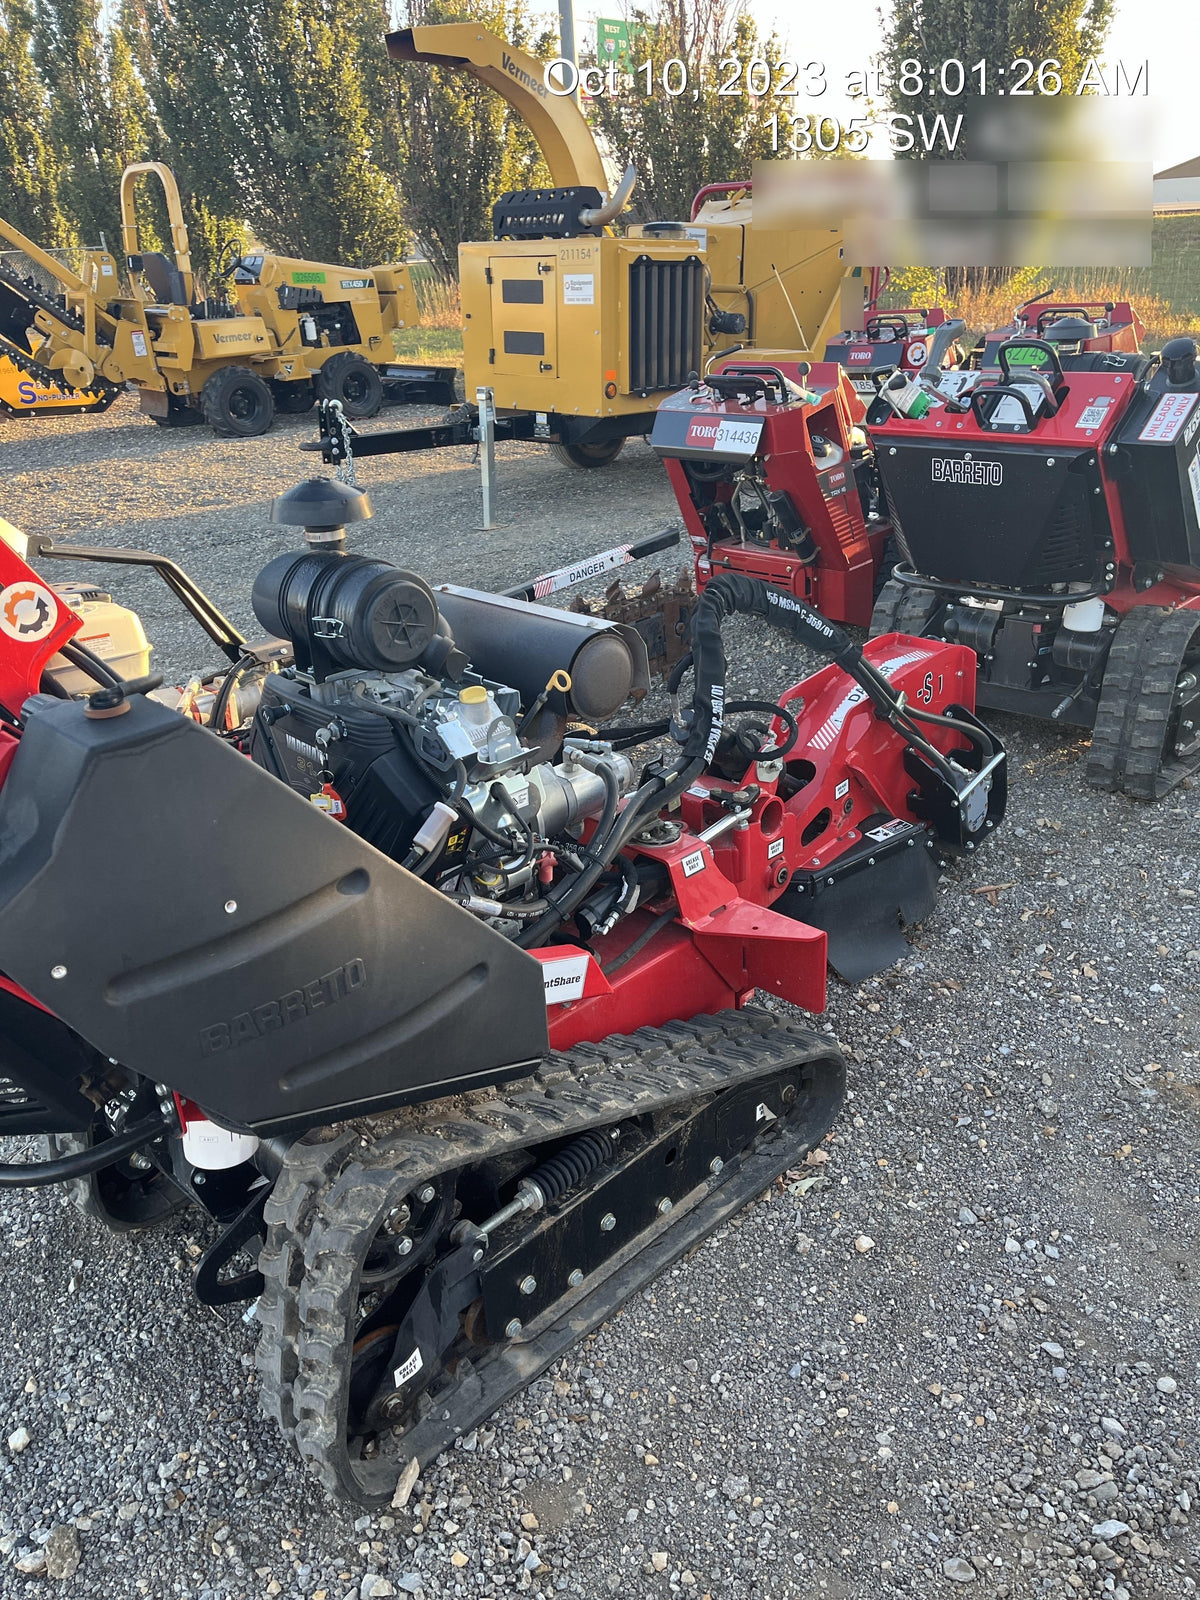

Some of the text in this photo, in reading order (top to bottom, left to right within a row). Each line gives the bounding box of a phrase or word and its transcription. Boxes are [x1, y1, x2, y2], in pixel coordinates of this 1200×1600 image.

[604, 24, 620, 33] WEST
[618, 40, 627, 48] TO
[502, 51, 549, 99] Vermeer
[560, 248, 591, 260] 211154
[213, 332, 252, 344] Vermeer
[850, 351, 872, 360] TORO
[854, 380, 876, 391] 185
[1145, 395, 1177, 438] UNLEADED
[1160, 418, 1179, 439] FUEL
[1173, 396, 1192, 418] ONLY
[690, 425, 759, 445] TORO 314436
[829, 472, 846, 484] TORO
[932, 457, 1003, 487] BARRETO
[569, 561, 606, 584] DANGER
[800, 609, 835, 638] C-359/01
[685, 855, 700, 866] GREASE
[688, 862, 699, 871] DAILY
[544, 975, 581, 989] ntShare
[200, 957, 367, 1057] BARRETO
